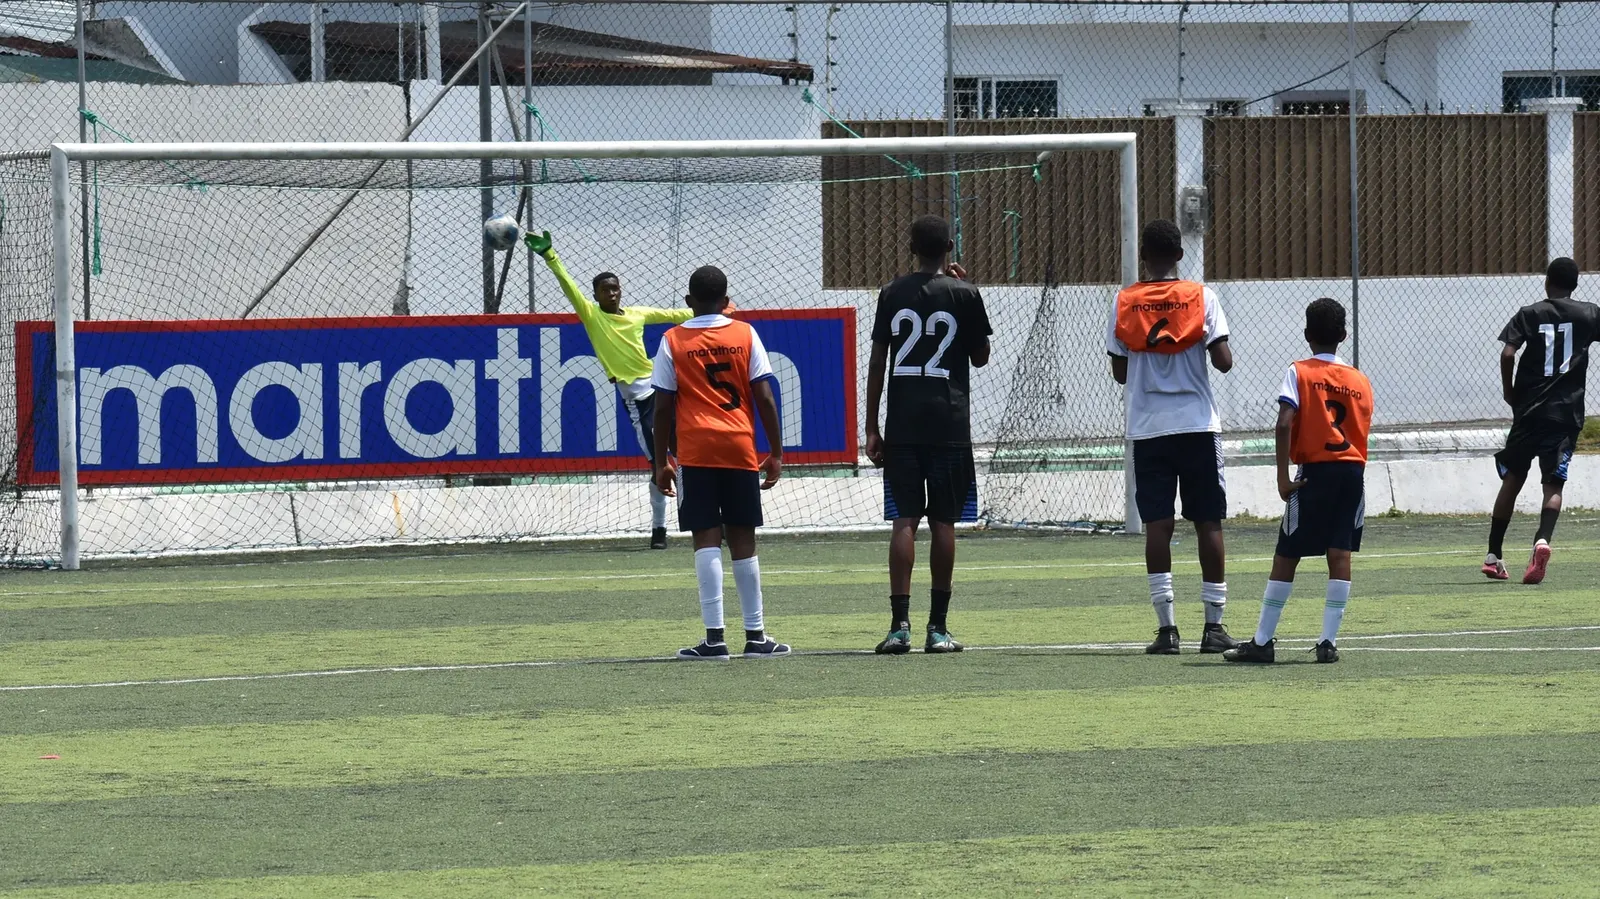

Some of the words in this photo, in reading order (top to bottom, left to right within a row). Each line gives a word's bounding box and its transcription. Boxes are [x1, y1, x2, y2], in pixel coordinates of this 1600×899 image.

[1132, 301, 1189, 312] marathon
[687, 345, 743, 358] marathon
[891, 308, 958, 379] 22
[1538, 322, 1573, 376] 11
[705, 362, 741, 411] 5
[1313, 381, 1362, 400] marathon
[1324, 400, 1352, 452] 3
